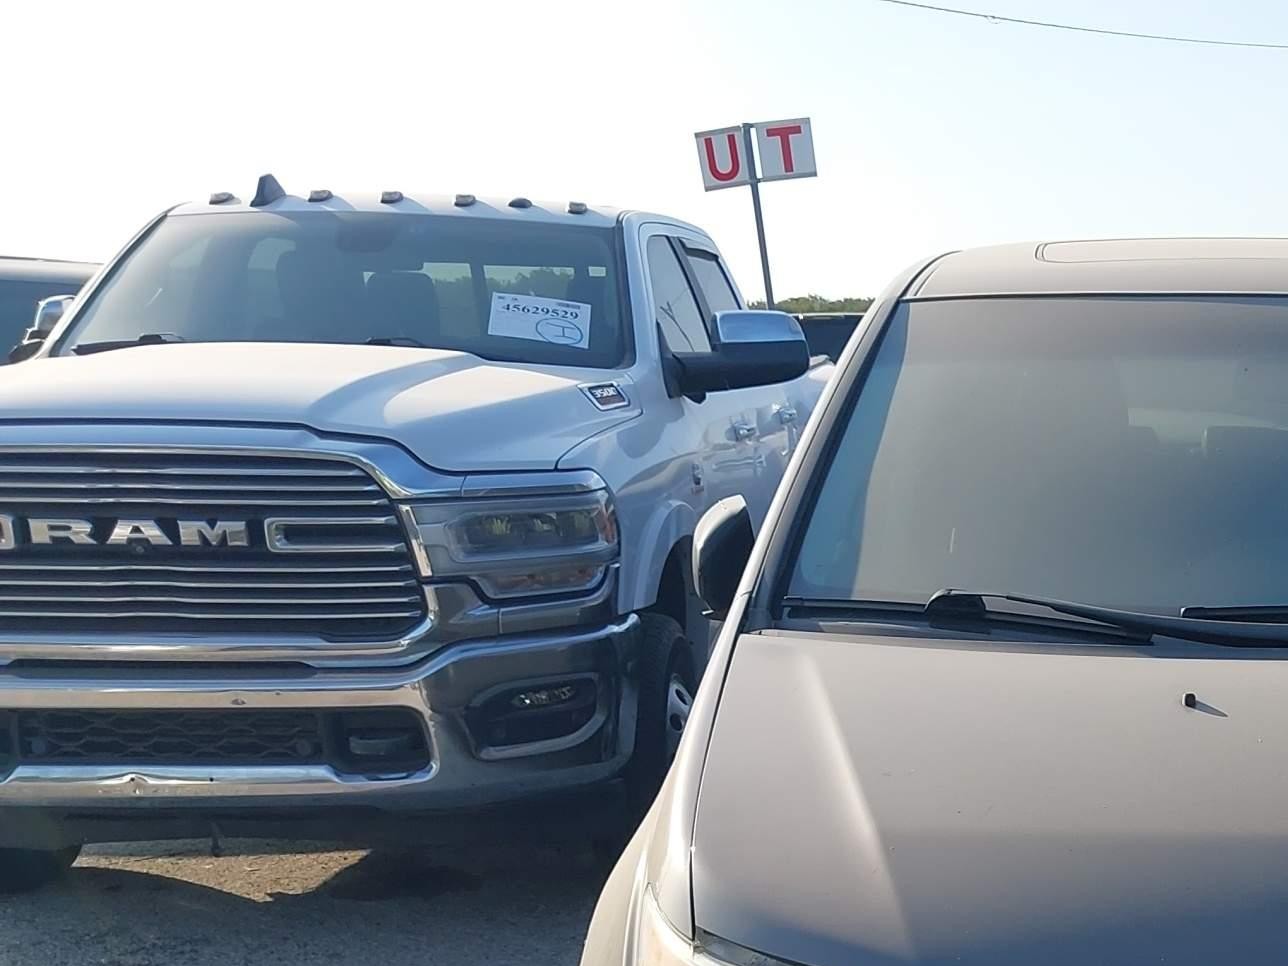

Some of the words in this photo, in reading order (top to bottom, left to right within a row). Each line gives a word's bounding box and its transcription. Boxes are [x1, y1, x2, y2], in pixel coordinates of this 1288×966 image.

[704, 133, 740, 182] U
[765, 125, 802, 173] T
[502, 303, 579, 319] 45629529
[27, 518, 249, 546] RAM
